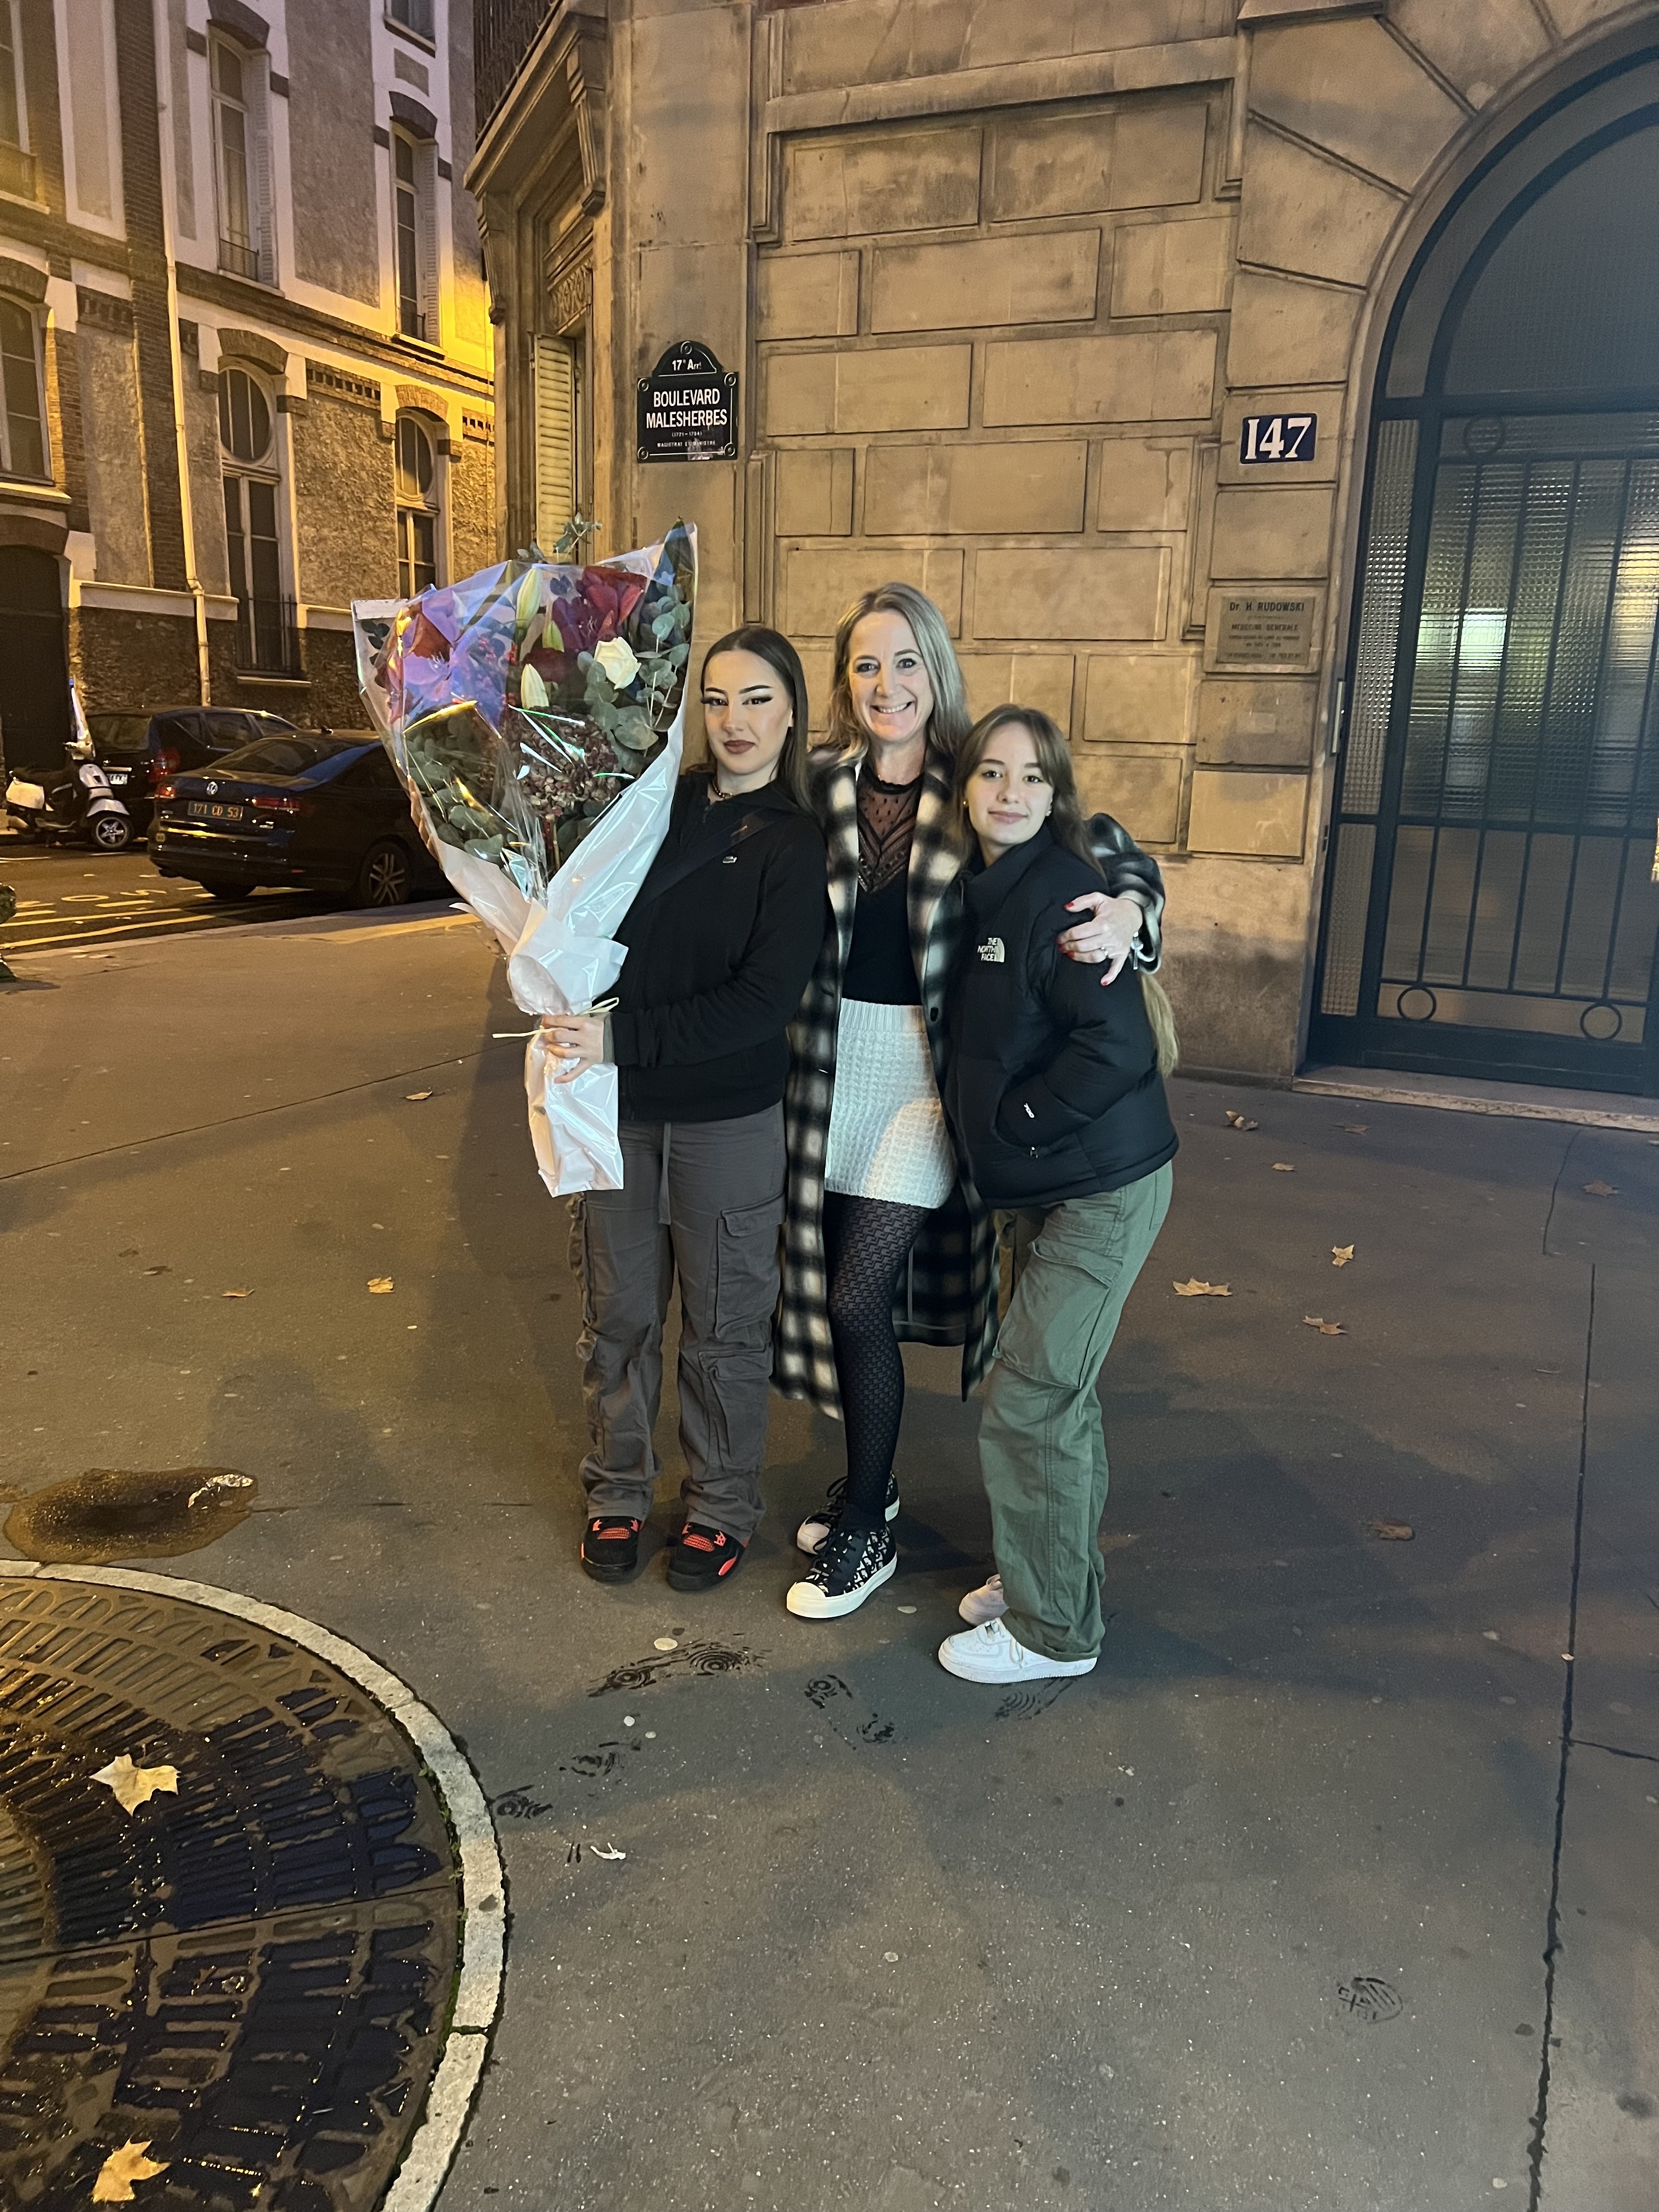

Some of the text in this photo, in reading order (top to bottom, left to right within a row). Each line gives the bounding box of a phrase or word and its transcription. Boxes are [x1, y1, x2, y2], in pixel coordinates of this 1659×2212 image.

[653, 388, 720, 407] BOULEVARD
[646, 409, 727, 428] MALESHERBES
[1245, 417, 1312, 459] 147
[1257, 602, 1305, 612] RUDOWSKI
[212, 805, 223, 816] CD
[228, 806, 239, 818] 53
